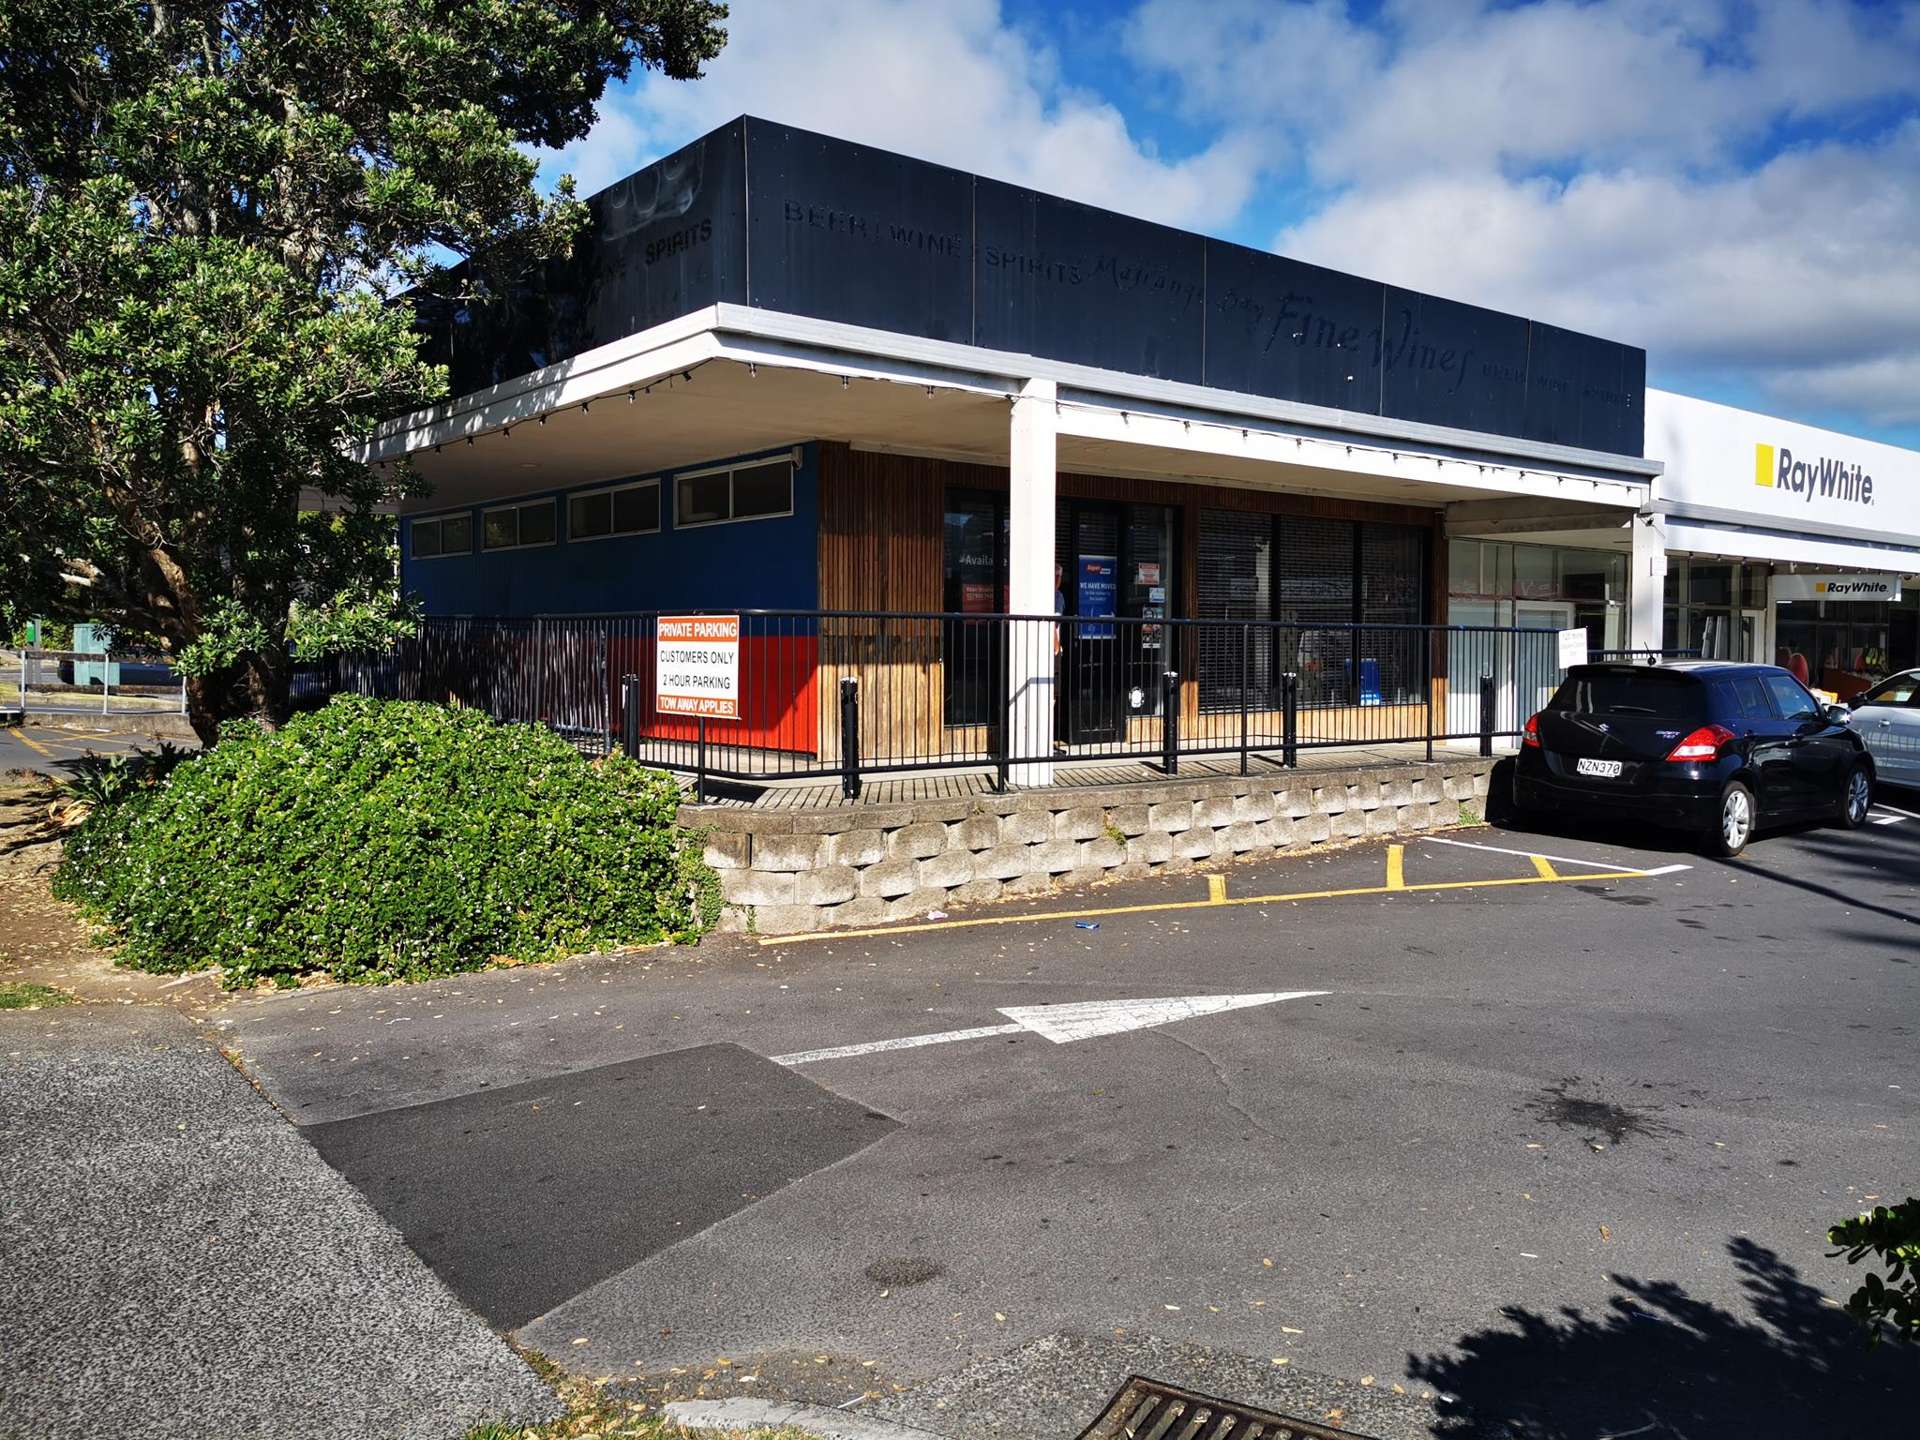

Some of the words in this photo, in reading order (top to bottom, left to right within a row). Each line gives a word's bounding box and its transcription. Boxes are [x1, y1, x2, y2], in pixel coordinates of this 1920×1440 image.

[645, 218, 712, 267] SPIRITS
[888, 224, 962, 259] WINE
[985, 245, 1082, 286] SPIRITS
[659, 623, 692, 637] PRIVATE
[694, 622, 737, 637] PARKING
[660, 650, 708, 664] CUSTOMERS
[710, 651, 734, 665] ONLY
[663, 674, 668, 686] 2
[669, 674, 691, 687] HOUR
[693, 675, 731, 690] PARKING
[660, 696, 677, 710] TOW
[676, 697, 701, 712] AWAY
[699, 699, 734, 715] APPLIES
[1578, 760, 1621, 775] NZN370
